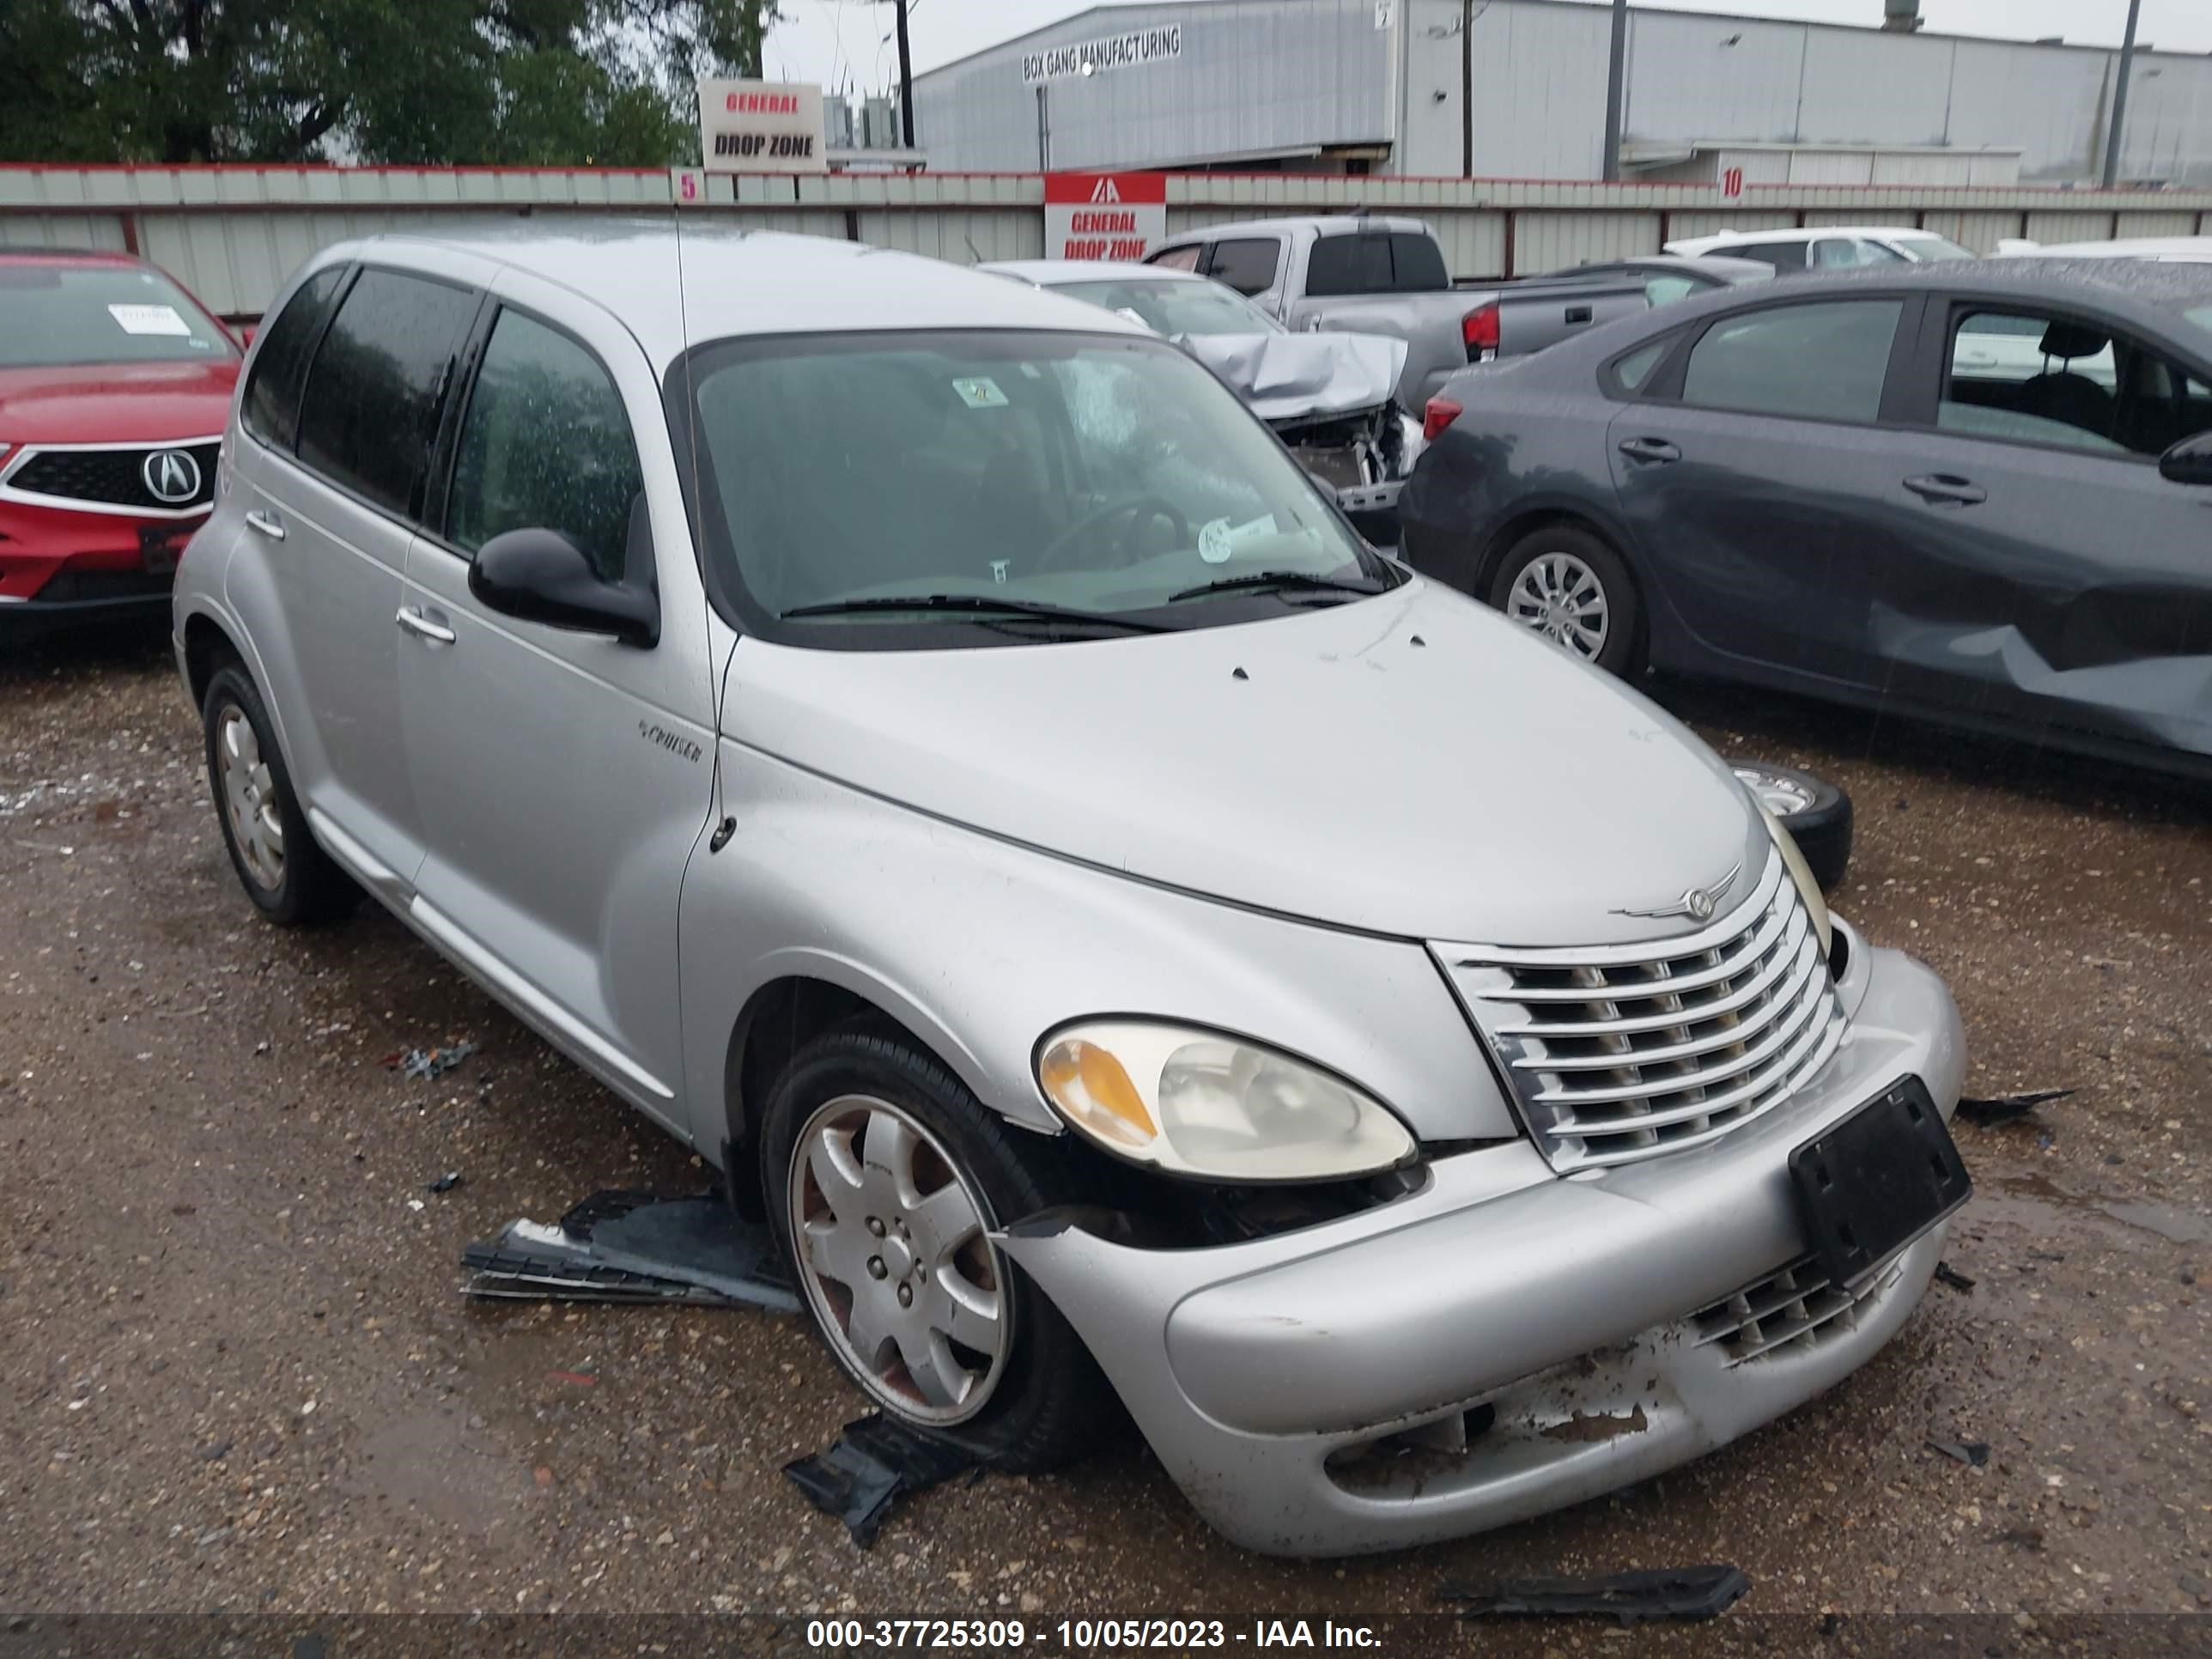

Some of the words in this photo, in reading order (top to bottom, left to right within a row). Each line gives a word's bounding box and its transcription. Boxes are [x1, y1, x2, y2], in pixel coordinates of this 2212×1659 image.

[1024, 52, 1044, 81] BOX
[1047, 48, 1077, 76] GANG
[1080, 27, 1179, 68] MANUFACTURING
[726, 93, 799, 114] GENERAL
[714, 134, 766, 156] DROP
[769, 135, 814, 158] ZONE
[681, 173, 696, 199] 5
[1723, 168, 1743, 197] 10
[1071, 212, 1136, 234] GENERAL
[1064, 240, 1107, 260] DROP
[1109, 240, 1147, 261] ZONE
